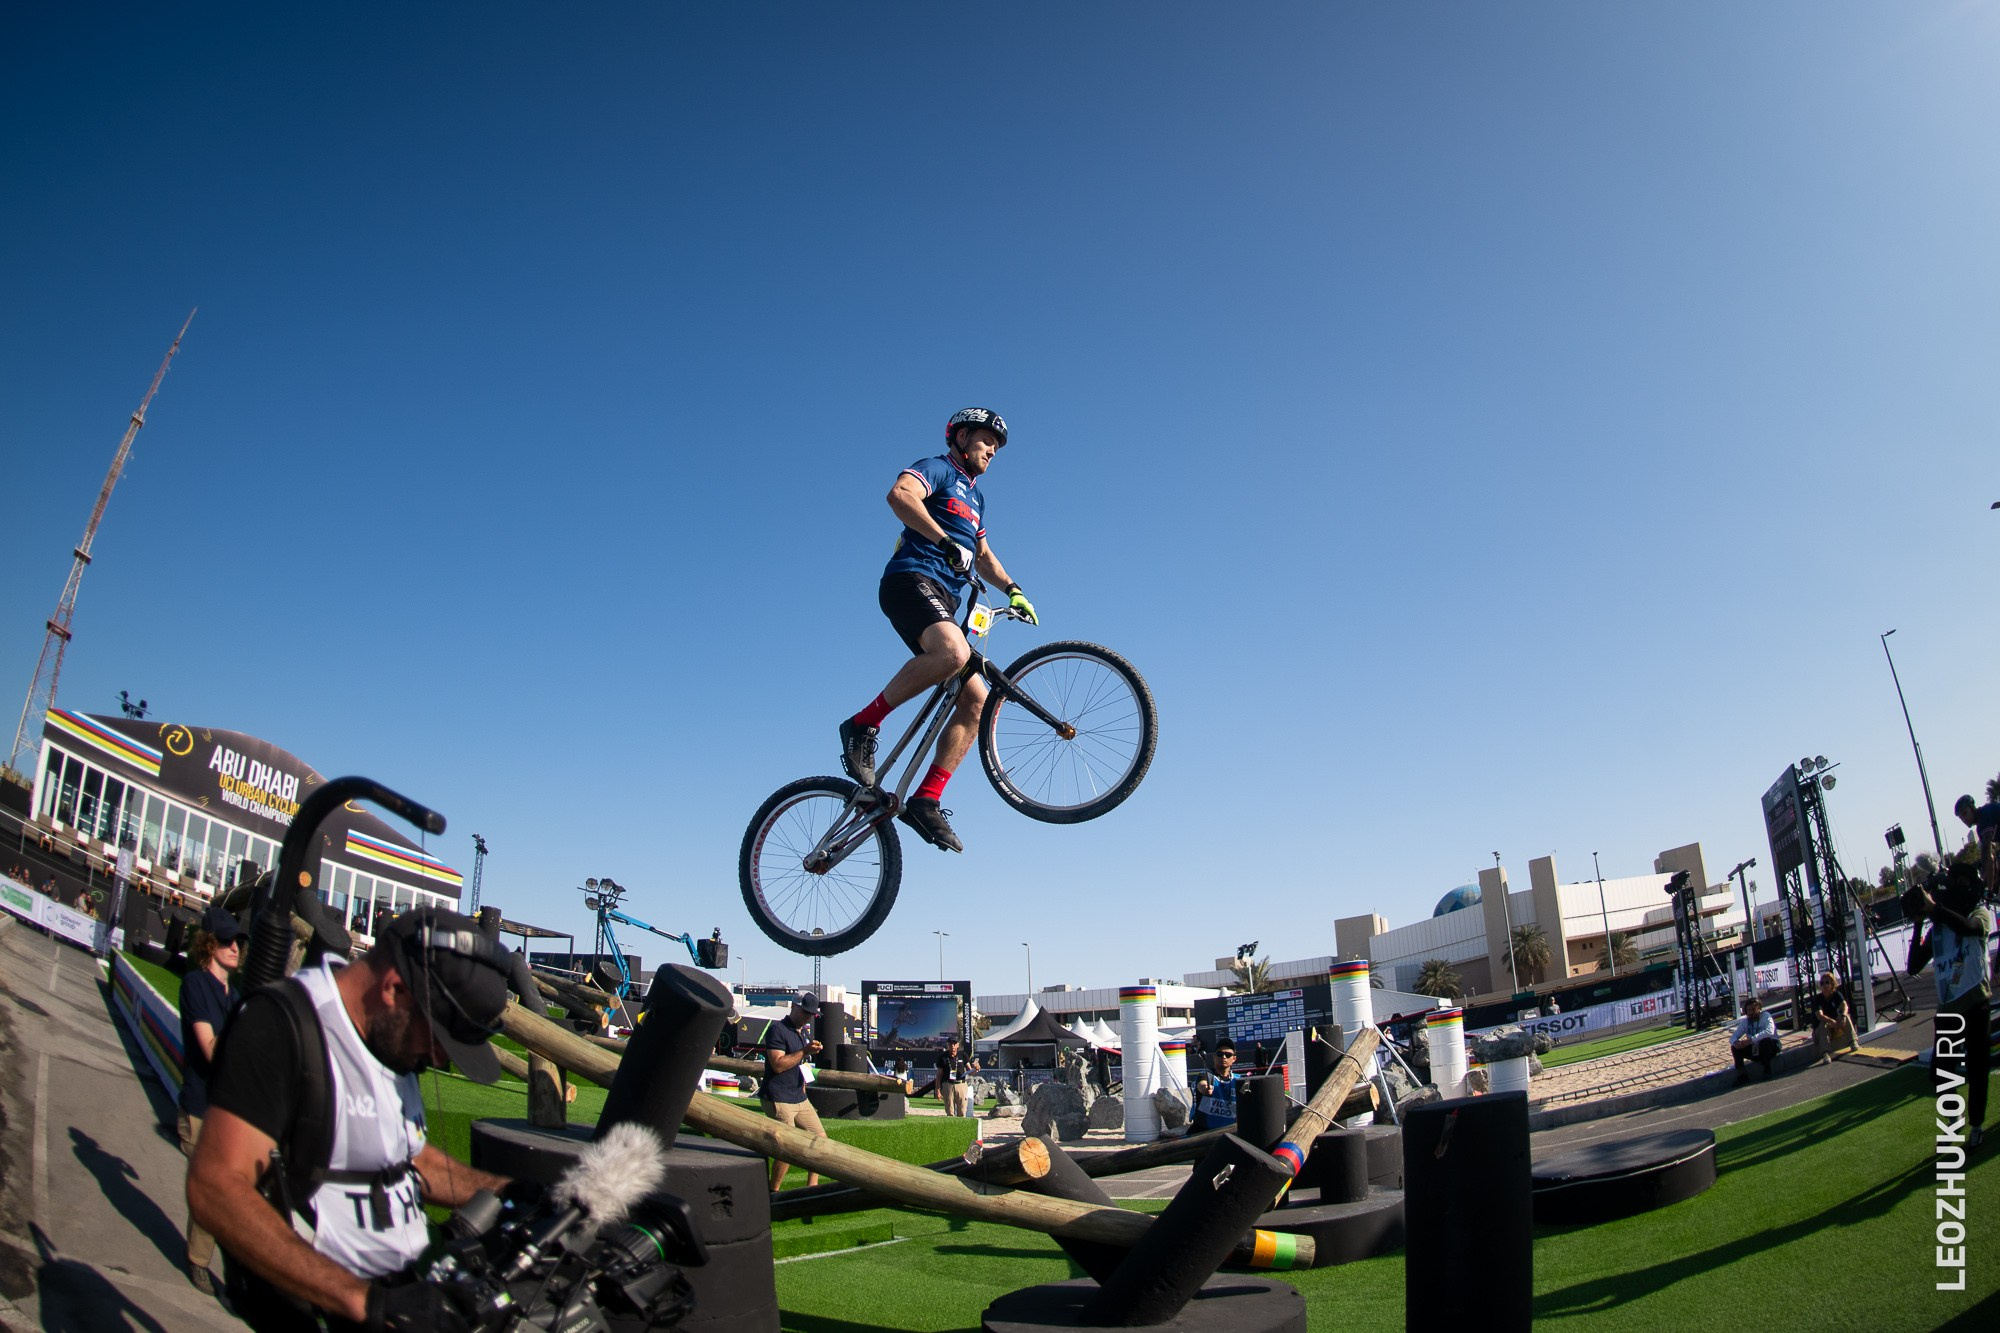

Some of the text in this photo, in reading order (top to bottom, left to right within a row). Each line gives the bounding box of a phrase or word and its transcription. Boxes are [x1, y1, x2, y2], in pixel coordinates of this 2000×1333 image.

[208, 745, 300, 803] ABU DHABI
[218, 773, 301, 816] UCI URBAN CYCLIN
[221, 788, 249, 810] WORLD
[879, 984, 893, 992] UCI
[1519, 1013, 1588, 1037] TISSOT
